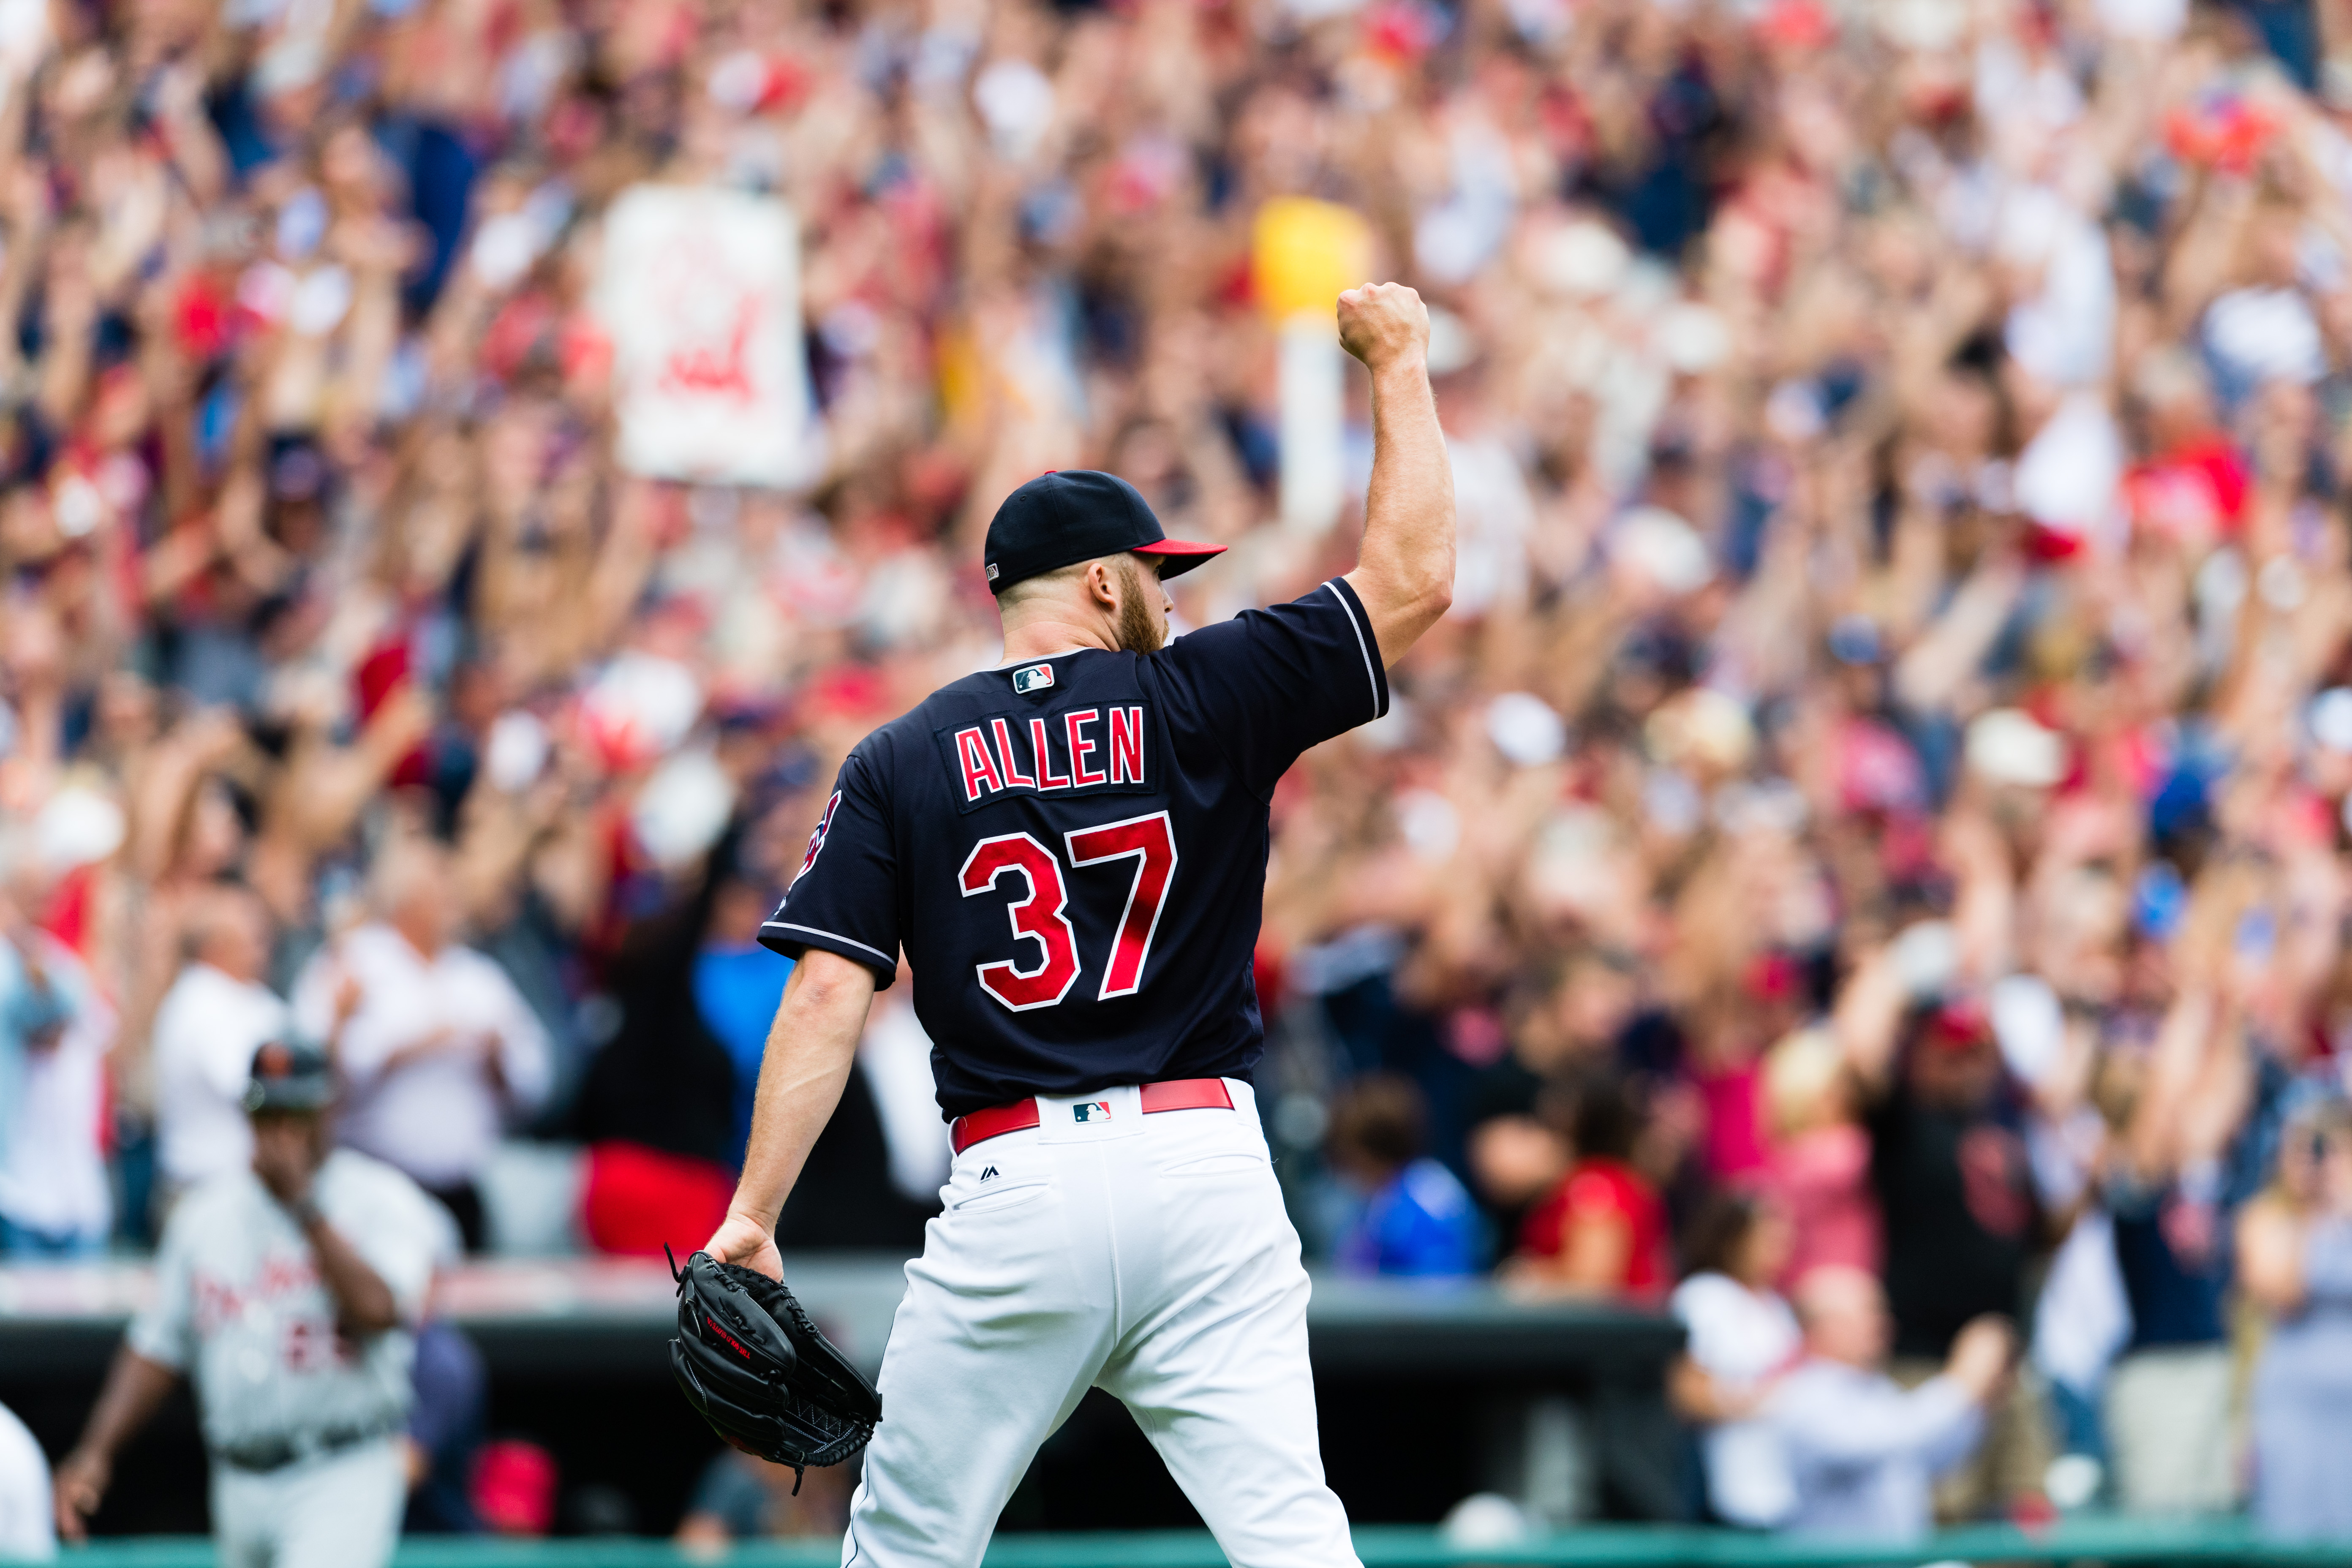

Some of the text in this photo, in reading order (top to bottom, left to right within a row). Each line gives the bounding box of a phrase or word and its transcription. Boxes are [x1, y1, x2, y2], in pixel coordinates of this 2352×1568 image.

[954, 706, 1144, 802] ALLEN
[958, 810, 1179, 1013] 37
[726, 1336, 740, 1350] GOLD
[739, 1346, 750, 1359] THE
